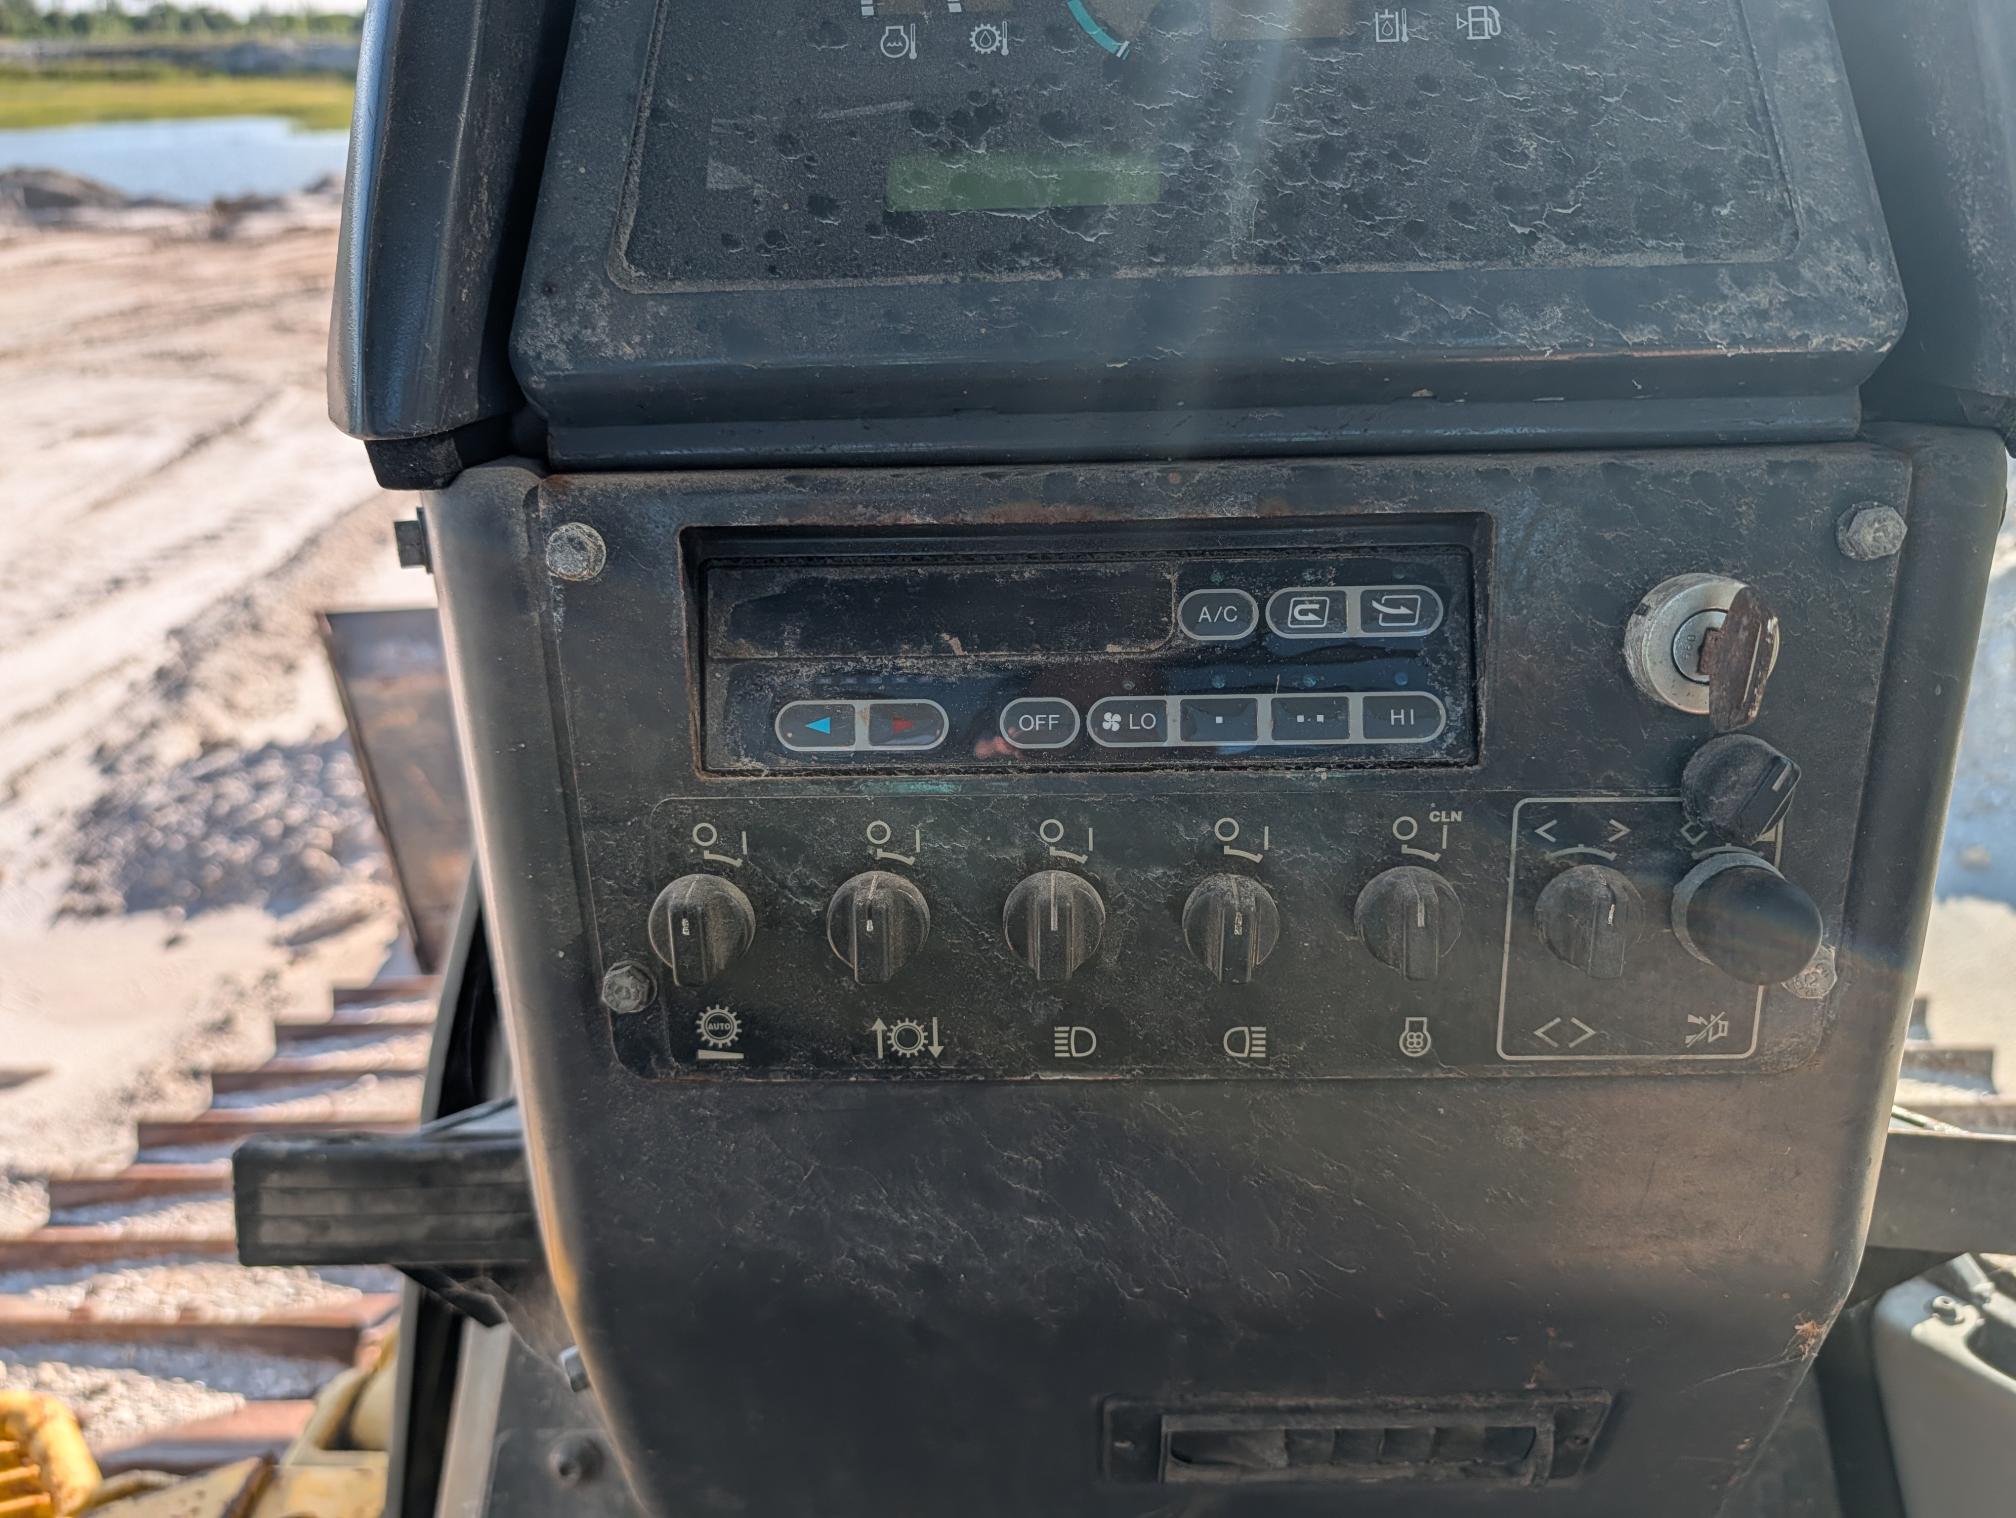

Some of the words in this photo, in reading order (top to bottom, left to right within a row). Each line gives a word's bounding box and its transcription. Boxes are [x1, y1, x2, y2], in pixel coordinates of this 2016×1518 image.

[1198, 605, 1238, 623] A/C
[1018, 714, 1061, 732] OFF
[1129, 713, 1157, 730] LO
[1390, 708, 1415, 726] HI
[1429, 810, 1463, 823] CLN
[708, 1022, 731, 1030] AUTO
